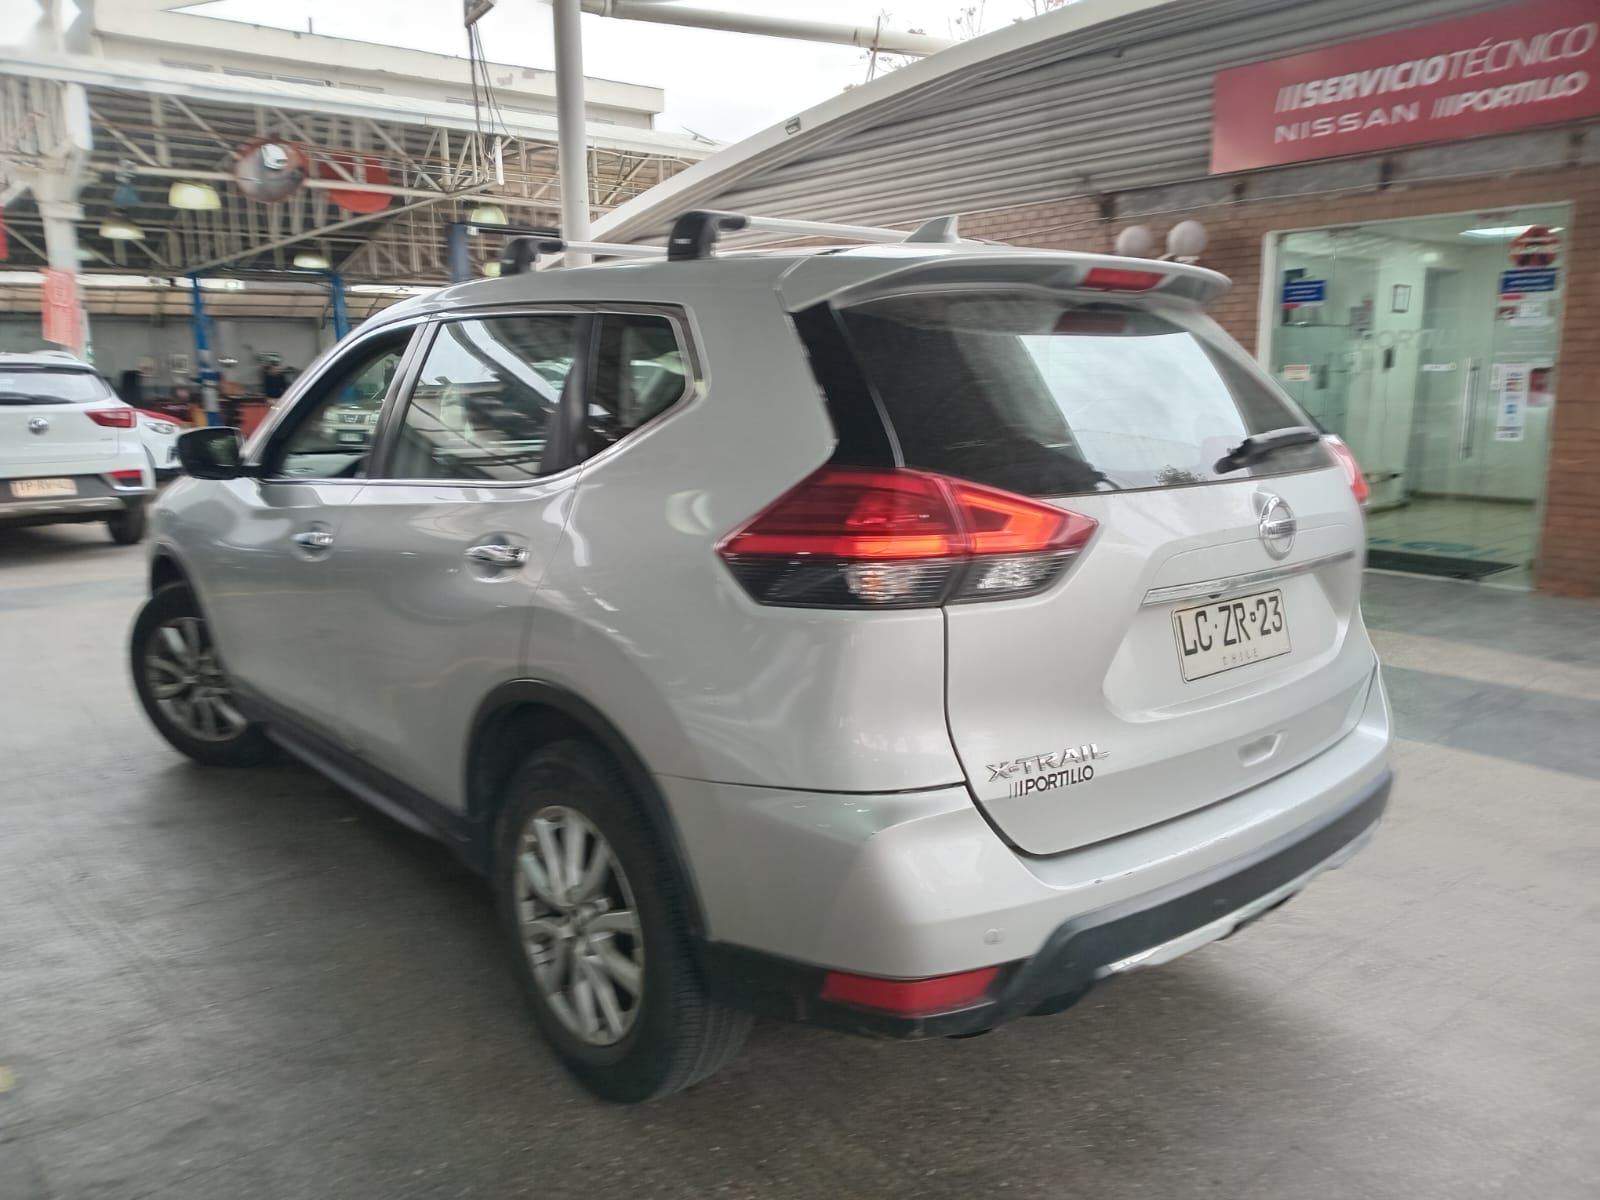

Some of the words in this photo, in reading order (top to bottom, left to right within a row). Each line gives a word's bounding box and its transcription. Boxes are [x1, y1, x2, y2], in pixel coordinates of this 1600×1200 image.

[1274, 101, 1421, 144] NISSAN
[986, 743, 1111, 782] X-TRAIL
[1025, 765, 1095, 795] PORTILLO
